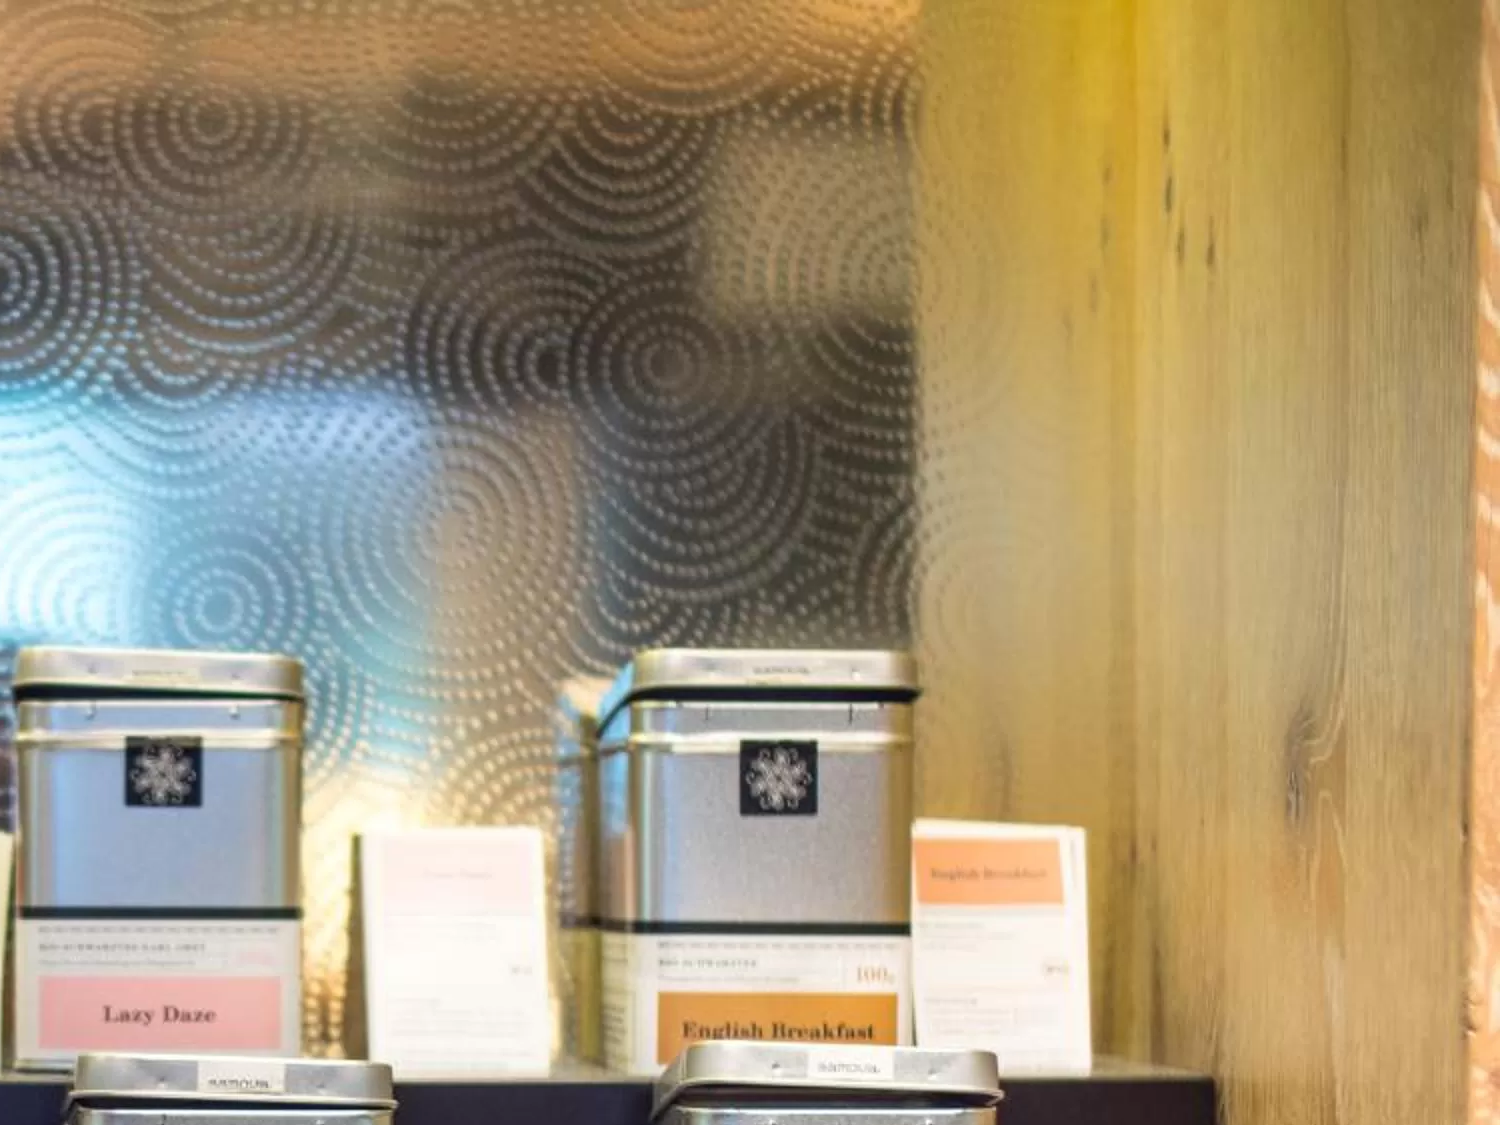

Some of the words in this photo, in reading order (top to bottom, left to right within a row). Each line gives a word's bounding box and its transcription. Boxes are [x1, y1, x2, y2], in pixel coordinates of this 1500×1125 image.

[102, 1005, 155, 1026] Lazy
[162, 1005, 218, 1023] Daze
[681, 1020, 764, 1040] English
[771, 1020, 875, 1040] Breakfast
